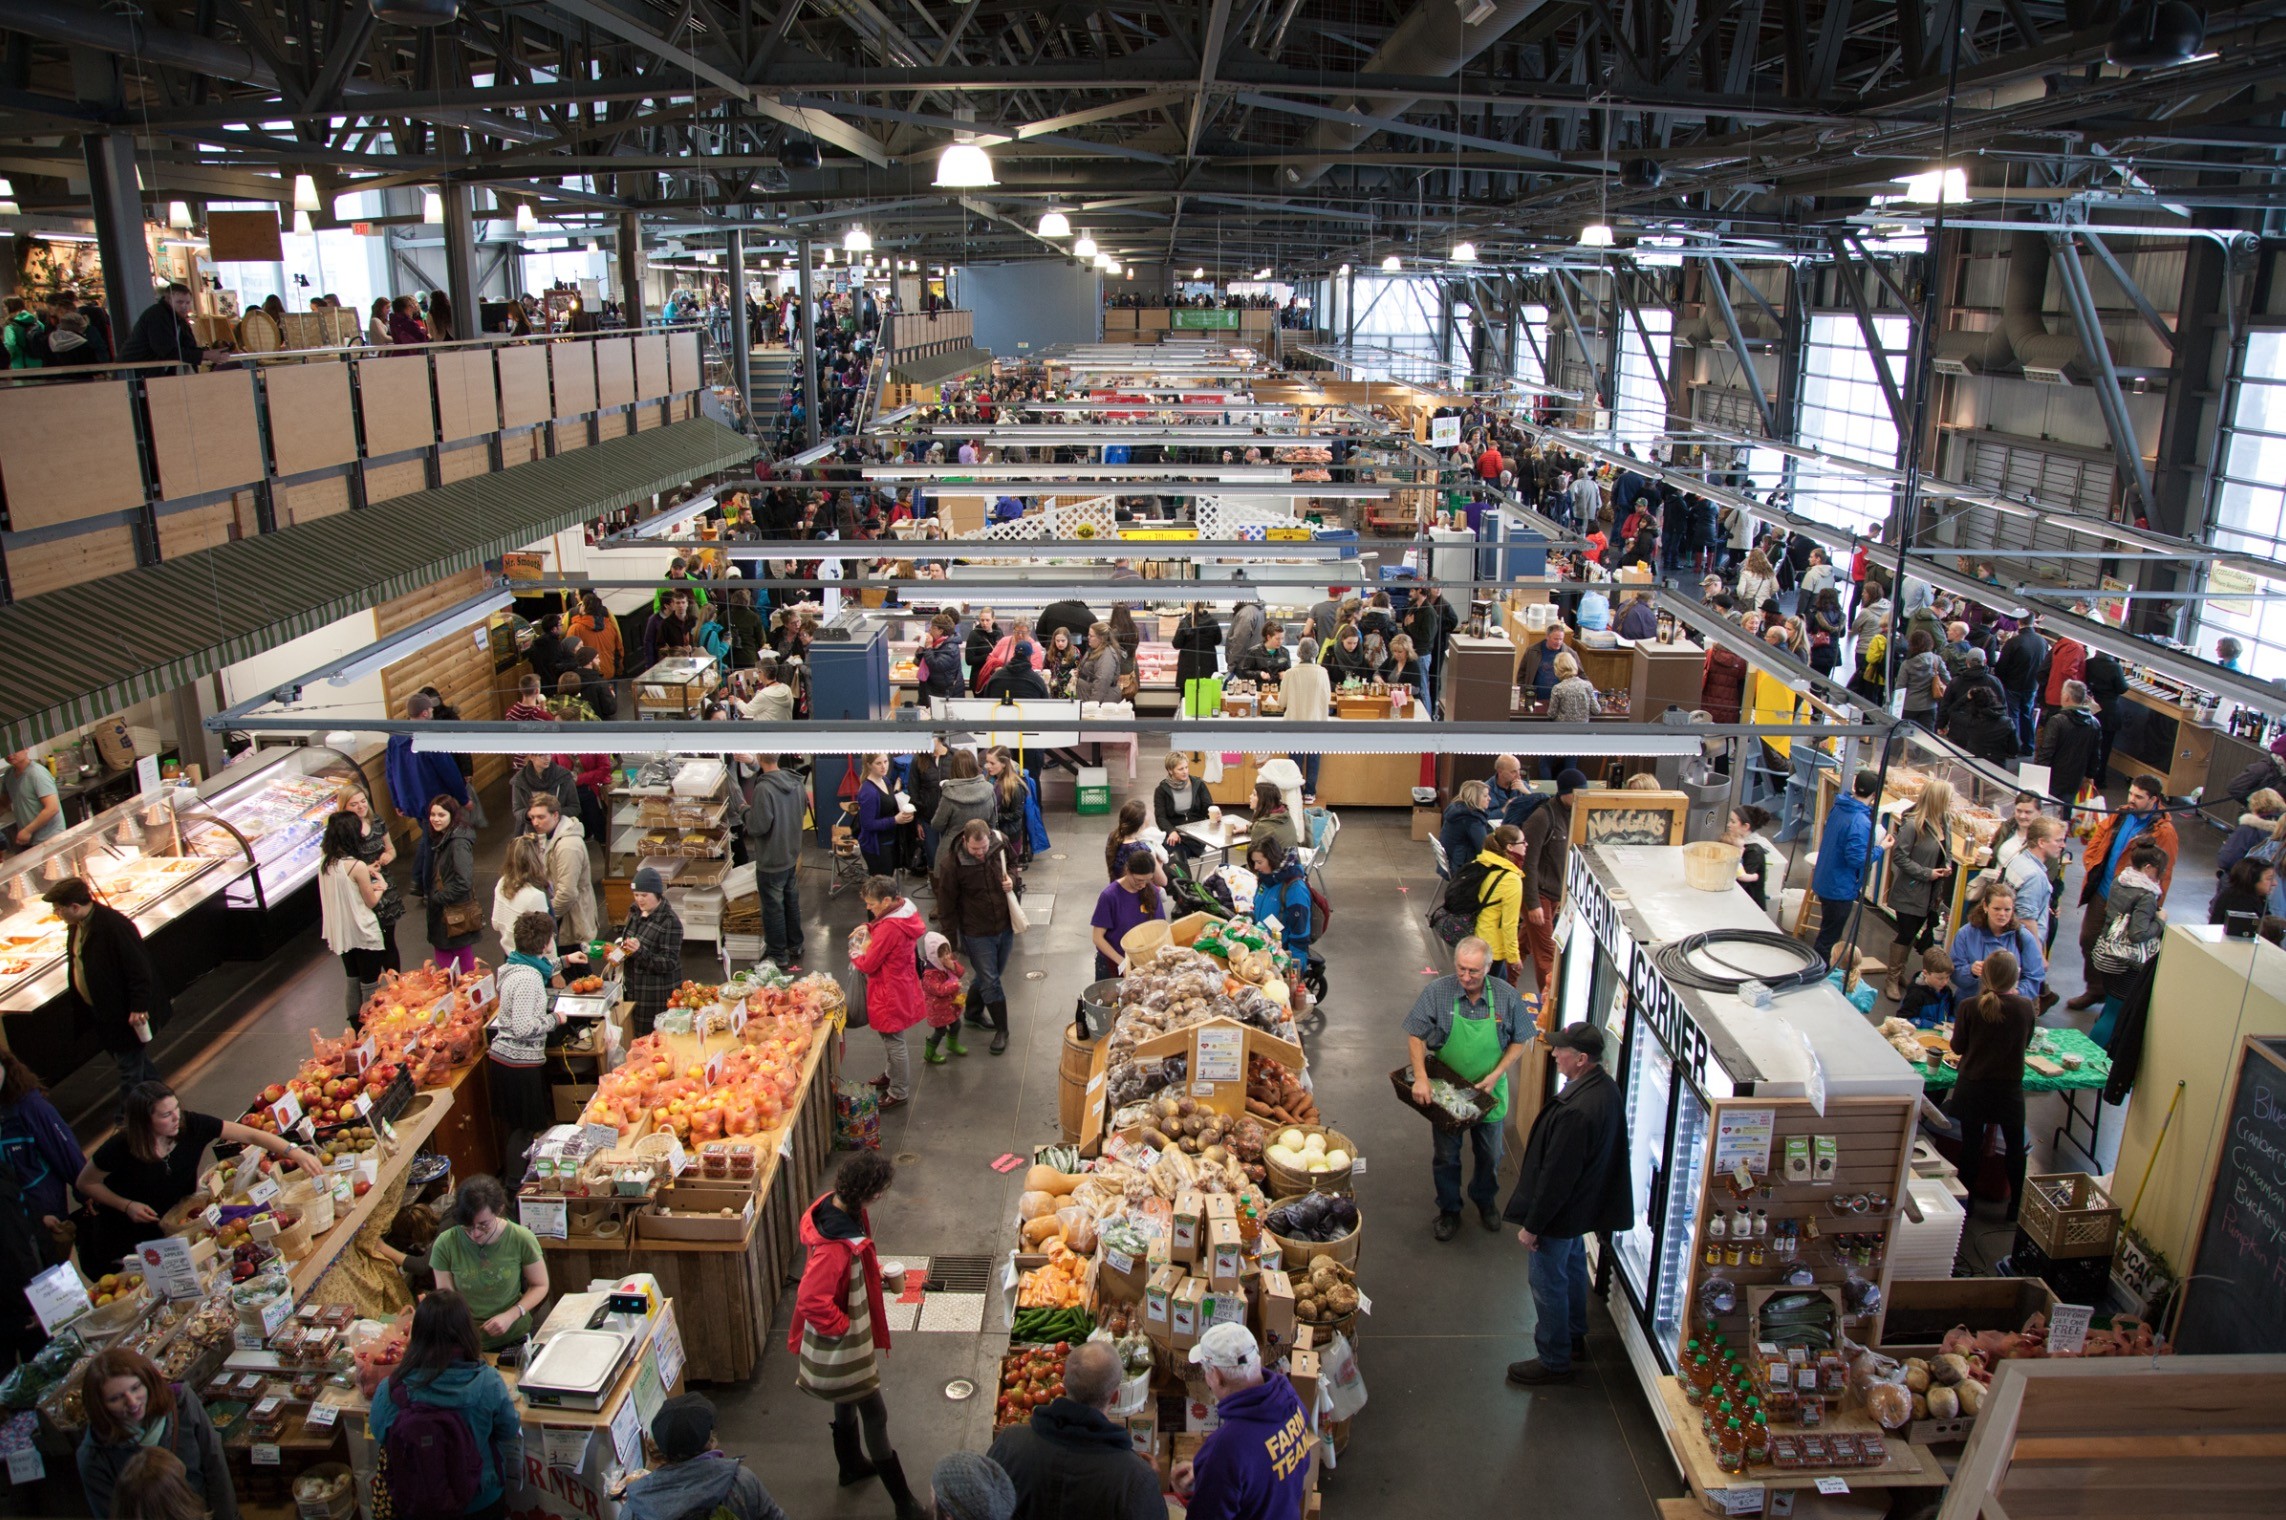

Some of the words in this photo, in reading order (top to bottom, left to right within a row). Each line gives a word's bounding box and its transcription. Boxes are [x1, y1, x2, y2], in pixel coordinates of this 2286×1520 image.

[355, 224, 369, 235] EXIT
[504, 557, 516, 568] Mr.
[517, 556, 542, 571] Smooth
[1588, 810, 1666, 838] NOGGINS
[1570, 858, 1621, 965] NOGGINS
[1635, 949, 1707, 1086] CORNER
[2253, 1085, 2286, 1131] Blue
[2232, 1146, 2285, 1213] Cinnamon
[2221, 1203, 2268, 1266] Pumpkin
[2233, 1176, 2286, 1243] Buckeye
[163, 1251, 185, 1259] APPLES
[2054, 1325, 2082, 1335] FREE
[1264, 1406, 1306, 1462] FARM
[1272, 1428, 1310, 1481] TEAM
[525, 1455, 601, 1520] RNER
